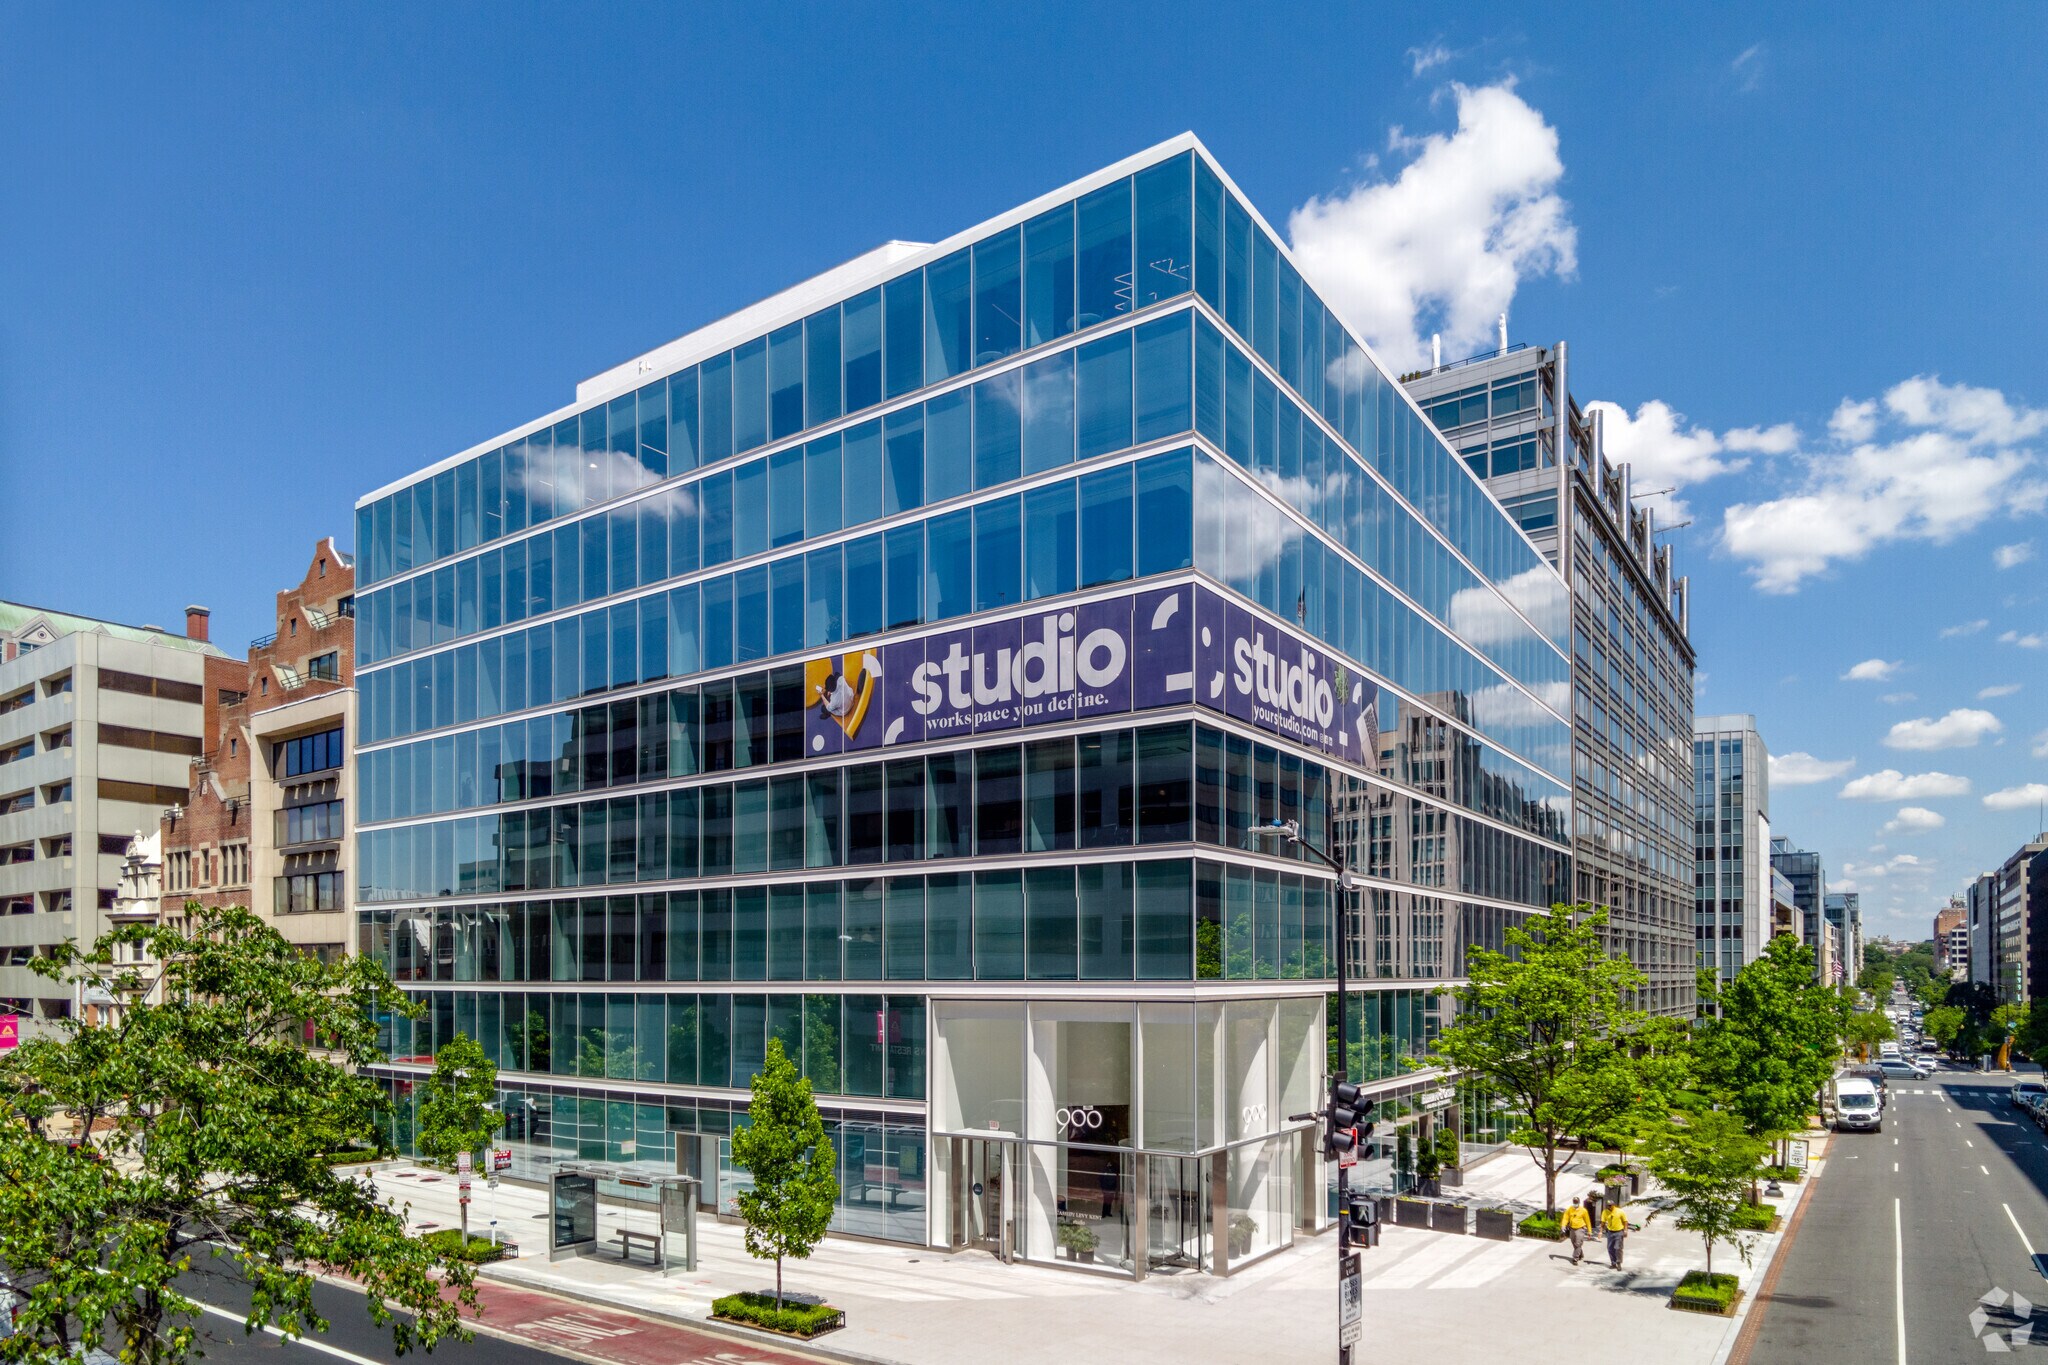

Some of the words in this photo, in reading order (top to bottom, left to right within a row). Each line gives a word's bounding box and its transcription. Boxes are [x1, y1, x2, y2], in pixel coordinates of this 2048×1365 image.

[911, 612, 1127, 715] studio
[1233, 632, 1334, 729] studio
[926, 708, 1010, 731] workspace
[1013, 700, 1044, 722] you
[1046, 690, 1109, 712] define.
[1253, 704, 1319, 742] yourstudio.com
[1056, 1108, 1102, 1134] 900
[1242, 1104, 1267, 1133] 900
[514, 1311, 644, 1344] ONLY
